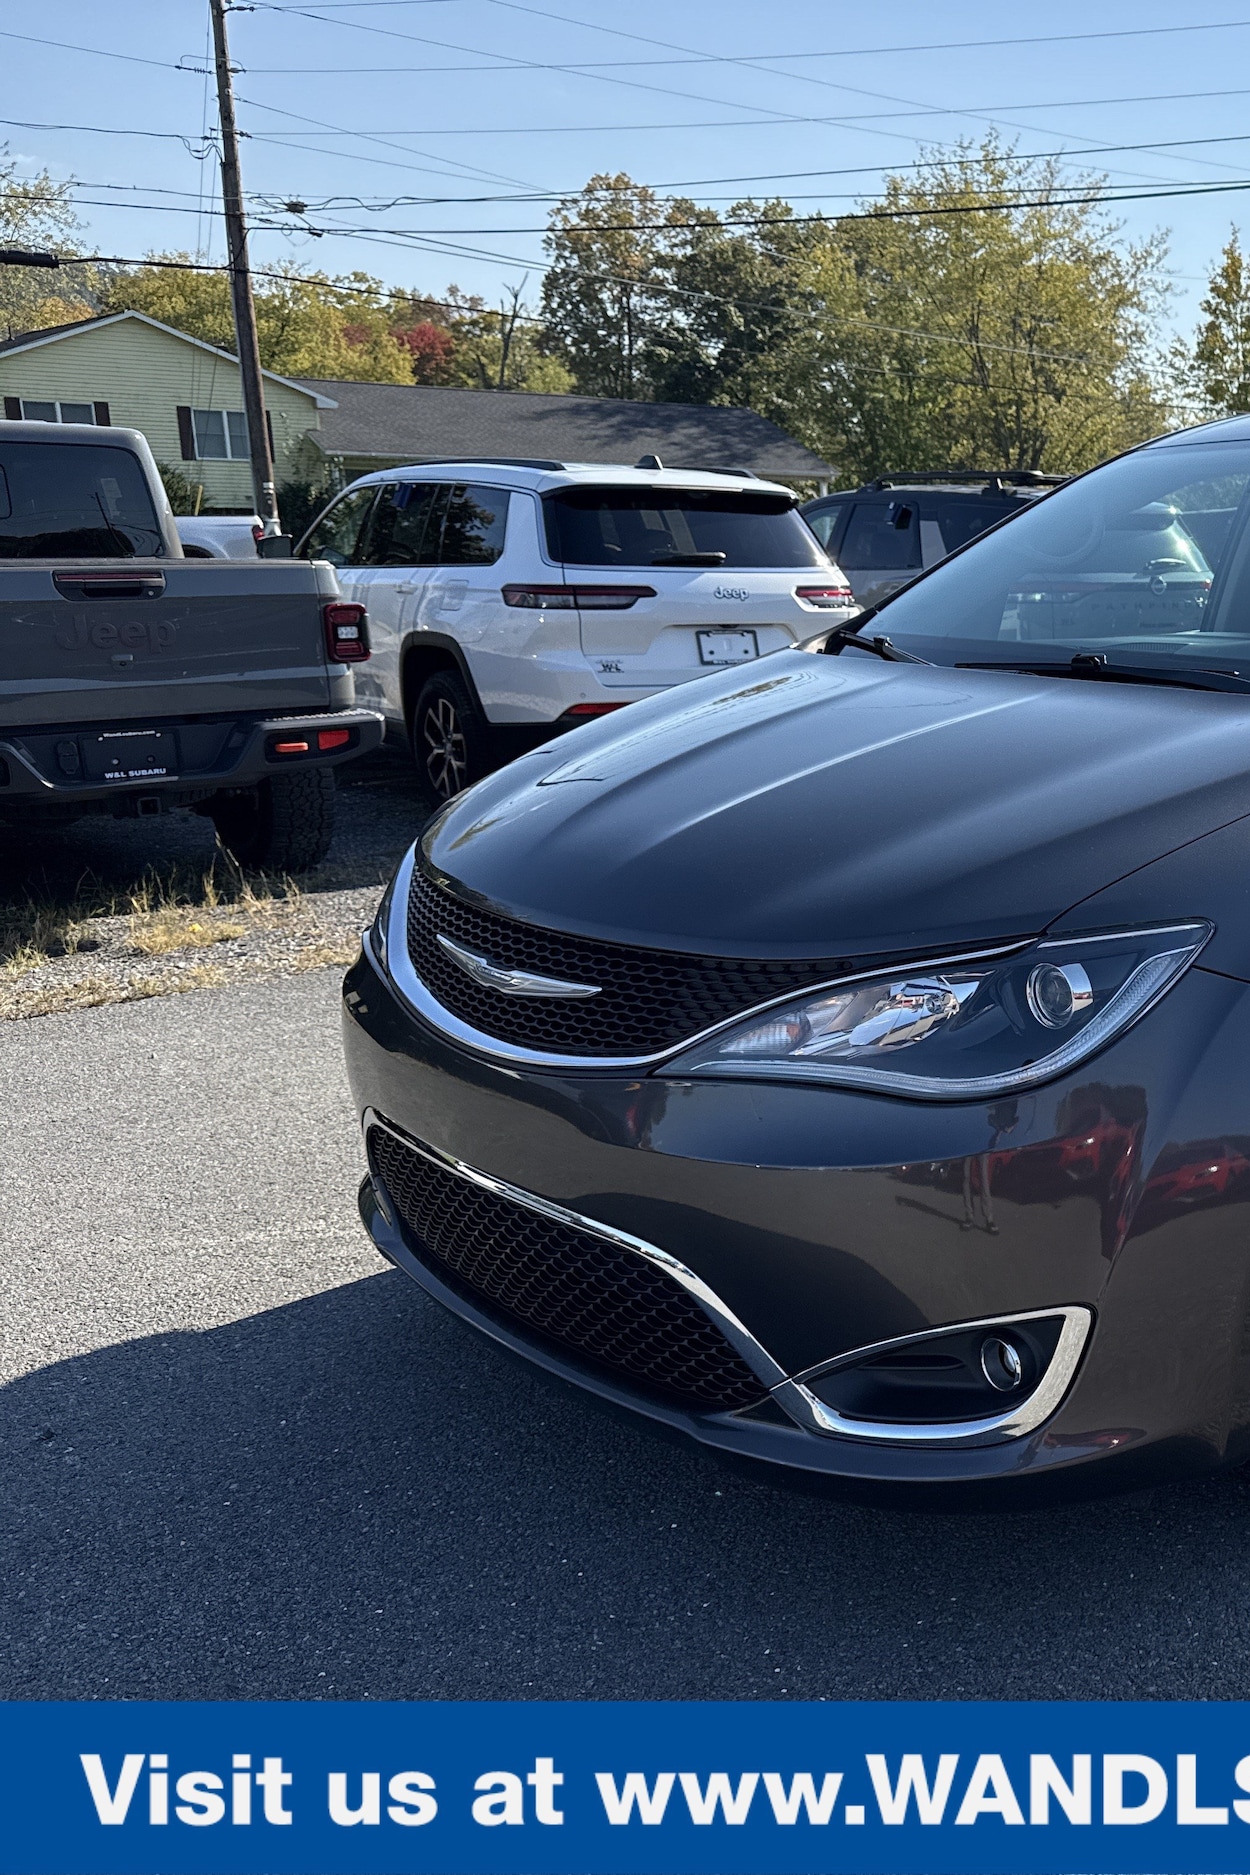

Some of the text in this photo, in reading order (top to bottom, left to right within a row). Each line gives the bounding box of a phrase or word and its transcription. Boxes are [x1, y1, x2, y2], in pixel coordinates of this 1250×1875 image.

[714, 586, 749, 601] Jeep
[56, 613, 176, 655] Jeep
[104, 767, 167, 779] W&L SUBARU
